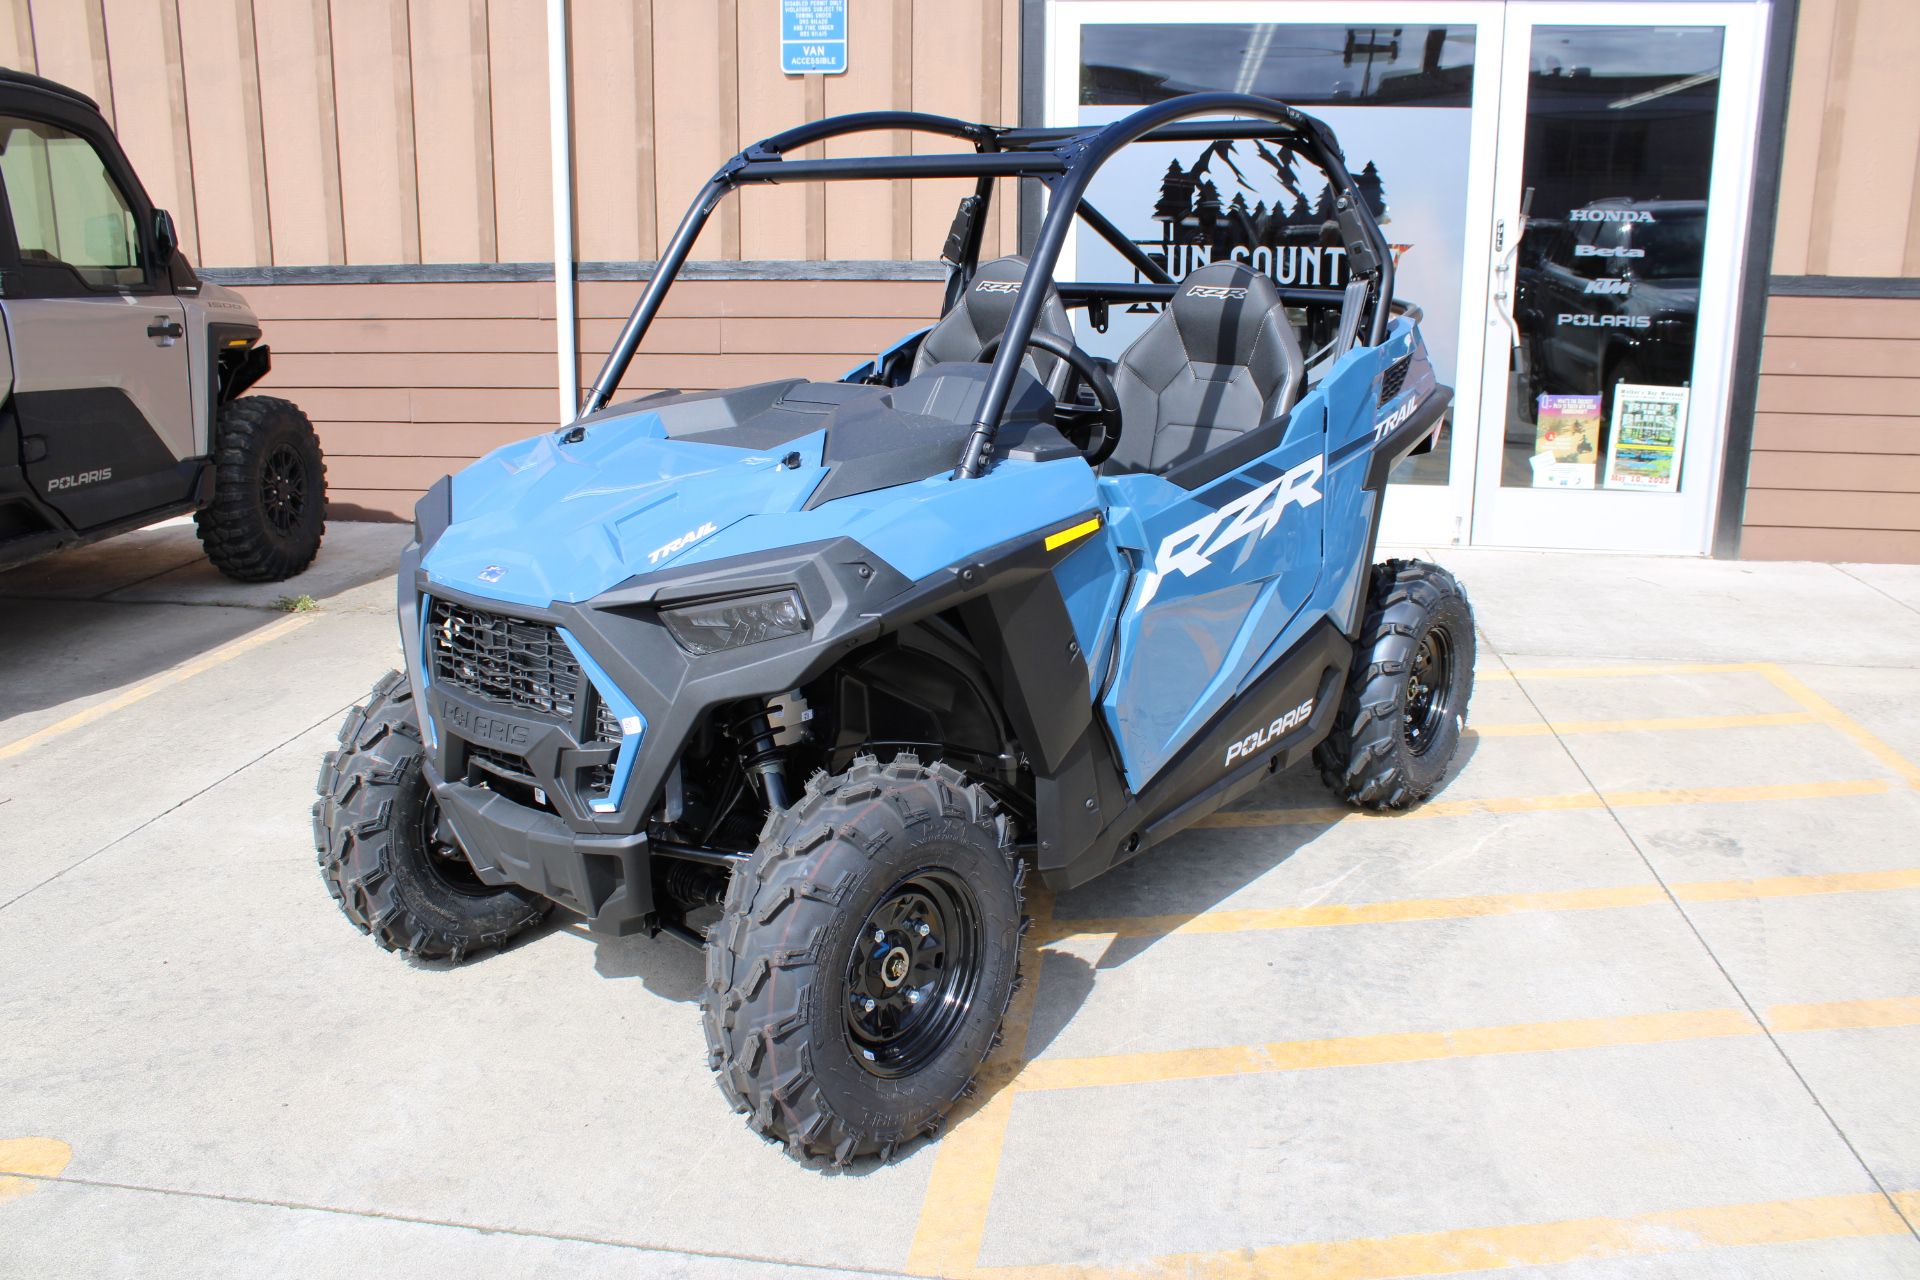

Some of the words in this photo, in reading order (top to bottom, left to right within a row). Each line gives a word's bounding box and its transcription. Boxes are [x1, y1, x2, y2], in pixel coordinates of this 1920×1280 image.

[803, 45, 825, 56] VAN
[792, 57, 836, 65] ACCESSIBLE
[1570, 209, 1656, 223] HONDA
[1575, 244, 1645, 258] Beta
[976, 280, 1023, 294] RZR
[1186, 285, 1249, 300] RZR
[1583, 278, 1632, 294] KTM
[1557, 313, 1651, 328] POLARIS
[1374, 395, 1418, 443] TRAIL
[48, 467, 112, 492] POLARIS
[1136, 453, 1323, 612] RZR
[647, 521, 718, 564] TRAIL
[443, 700, 531, 745] POLARIS
[1225, 698, 1313, 767] POLARIS
